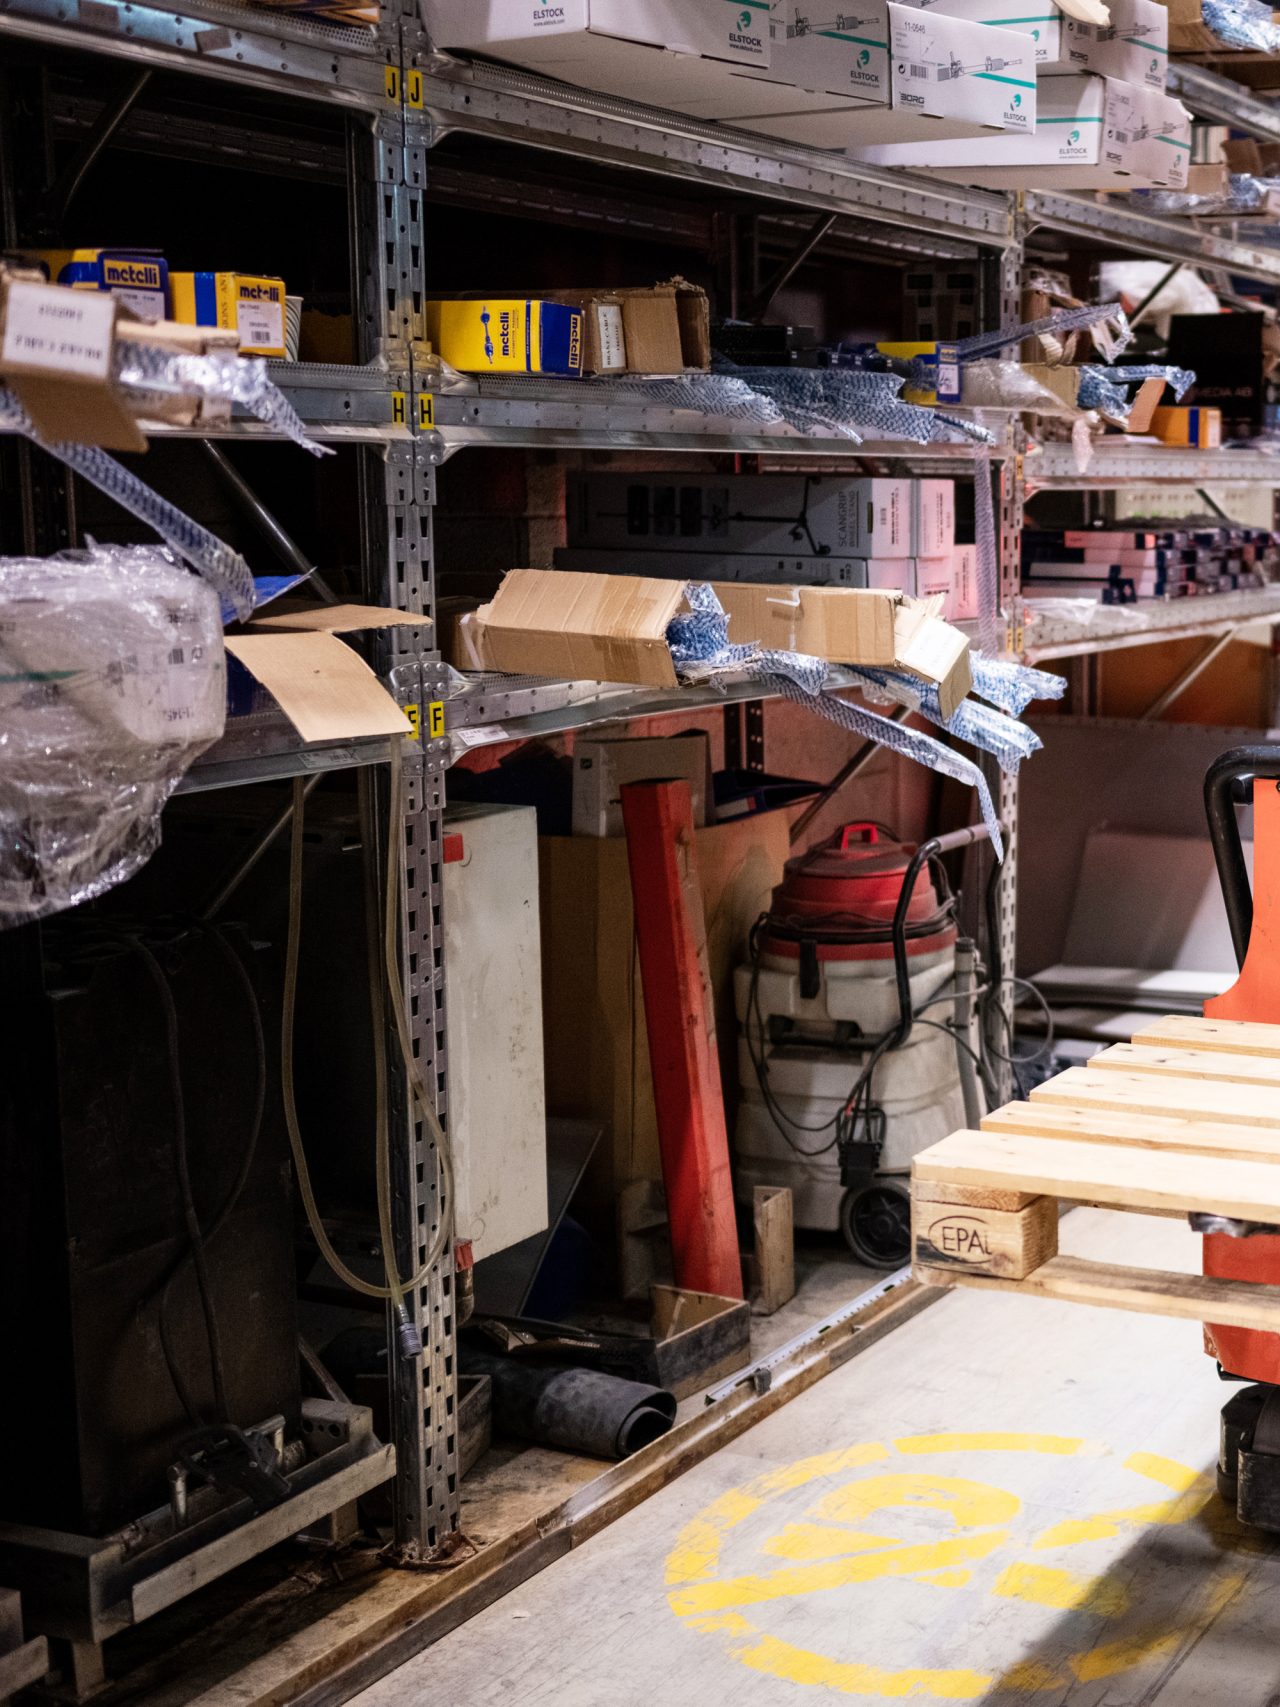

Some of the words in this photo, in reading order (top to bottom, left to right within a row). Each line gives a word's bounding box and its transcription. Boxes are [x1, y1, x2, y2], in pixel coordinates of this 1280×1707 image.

[533, 8, 564, 20] ELSTOCK
[729, 33, 762, 47] ELSTOCK
[388, 72, 396, 98] J
[851, 71, 879, 82] ELSTOCK
[411, 77, 420, 102] J
[1003, 112, 1027, 122] ELSTOCK
[1059, 147, 1087, 155] ELSTOCK
[500, 312, 510, 357] metelli
[394, 397, 404, 422] H
[421, 399, 431, 424] H
[838, 491, 847, 548] SCANGRIP
[433, 707, 442, 731] F
[942, 1226, 993, 1256] EPAL
